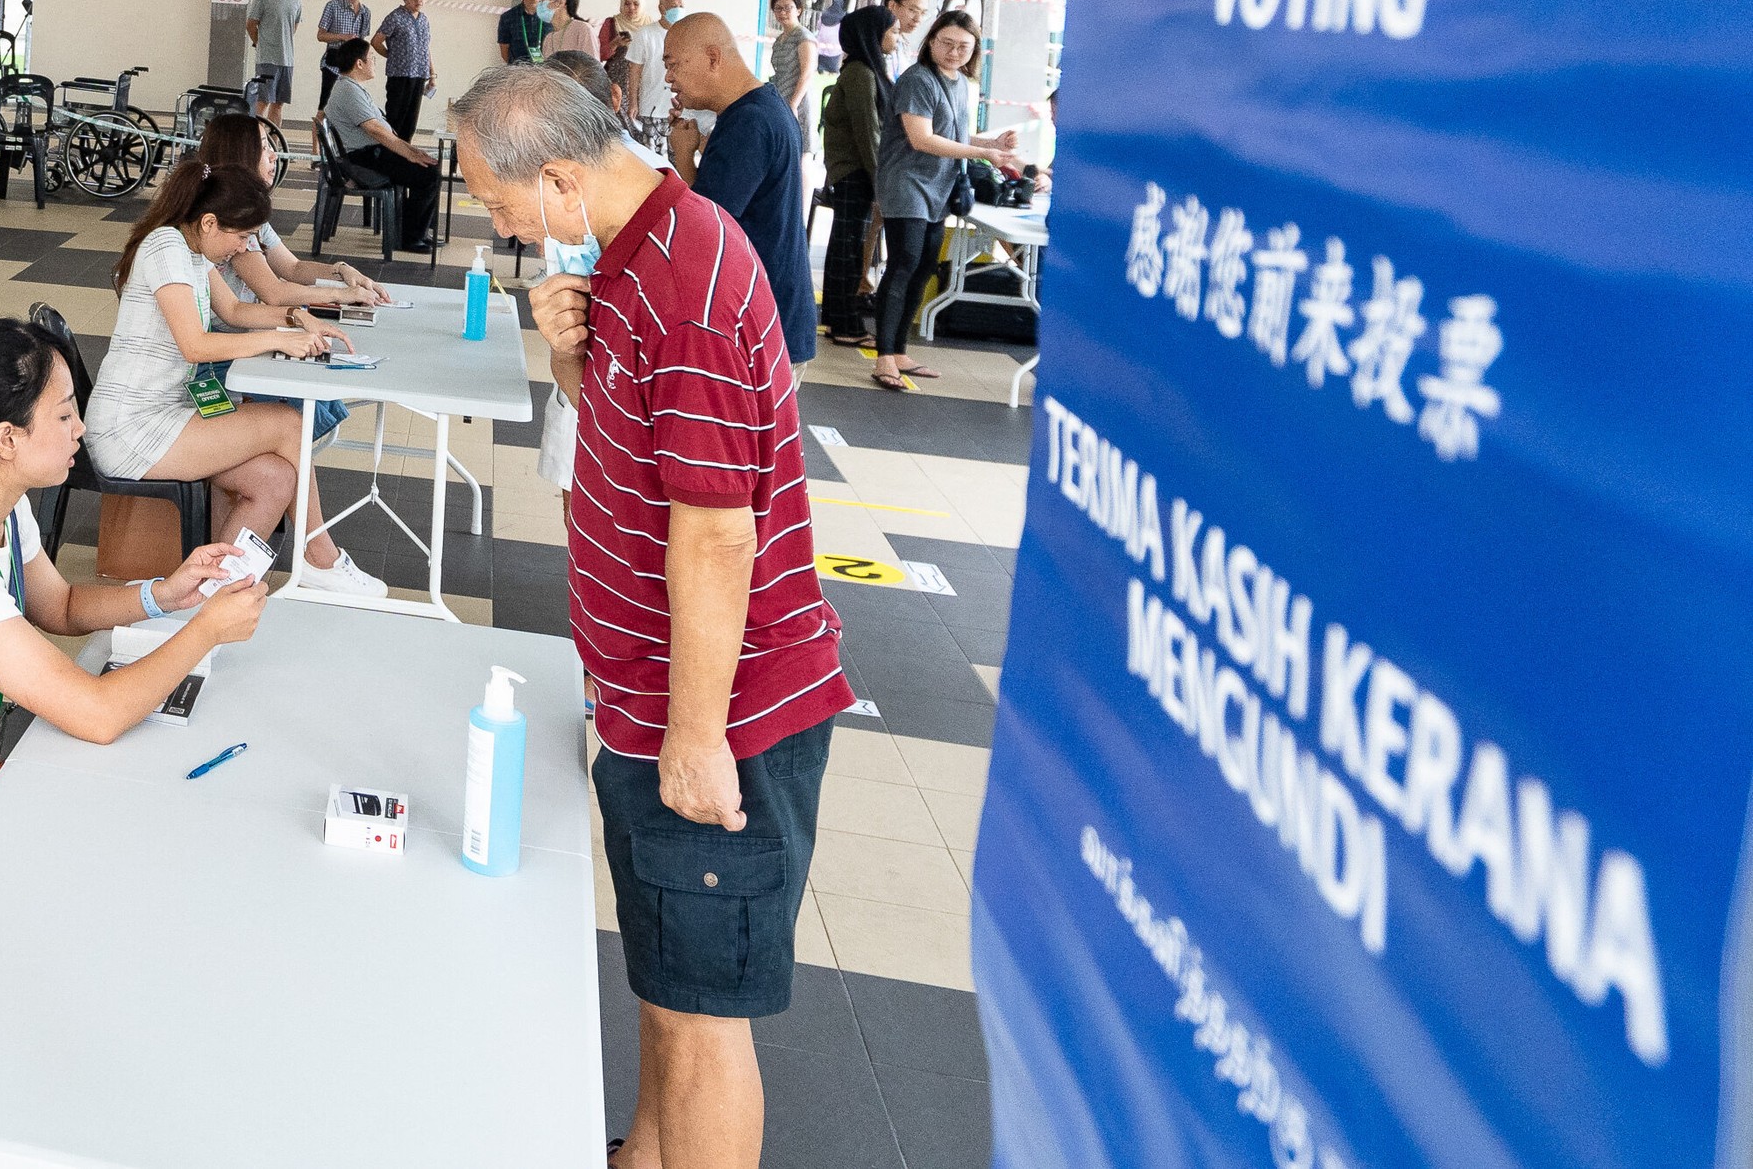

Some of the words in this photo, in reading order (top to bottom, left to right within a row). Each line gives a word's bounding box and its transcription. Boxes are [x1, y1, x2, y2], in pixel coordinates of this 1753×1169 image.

[824, 555, 883, 579] 2
[1044, 396, 1165, 580] TERIMA
[1171, 499, 1312, 719] KASIH
[1320, 623, 1666, 1063] KERANA
[1127, 579, 1388, 954] MENGUNDI
